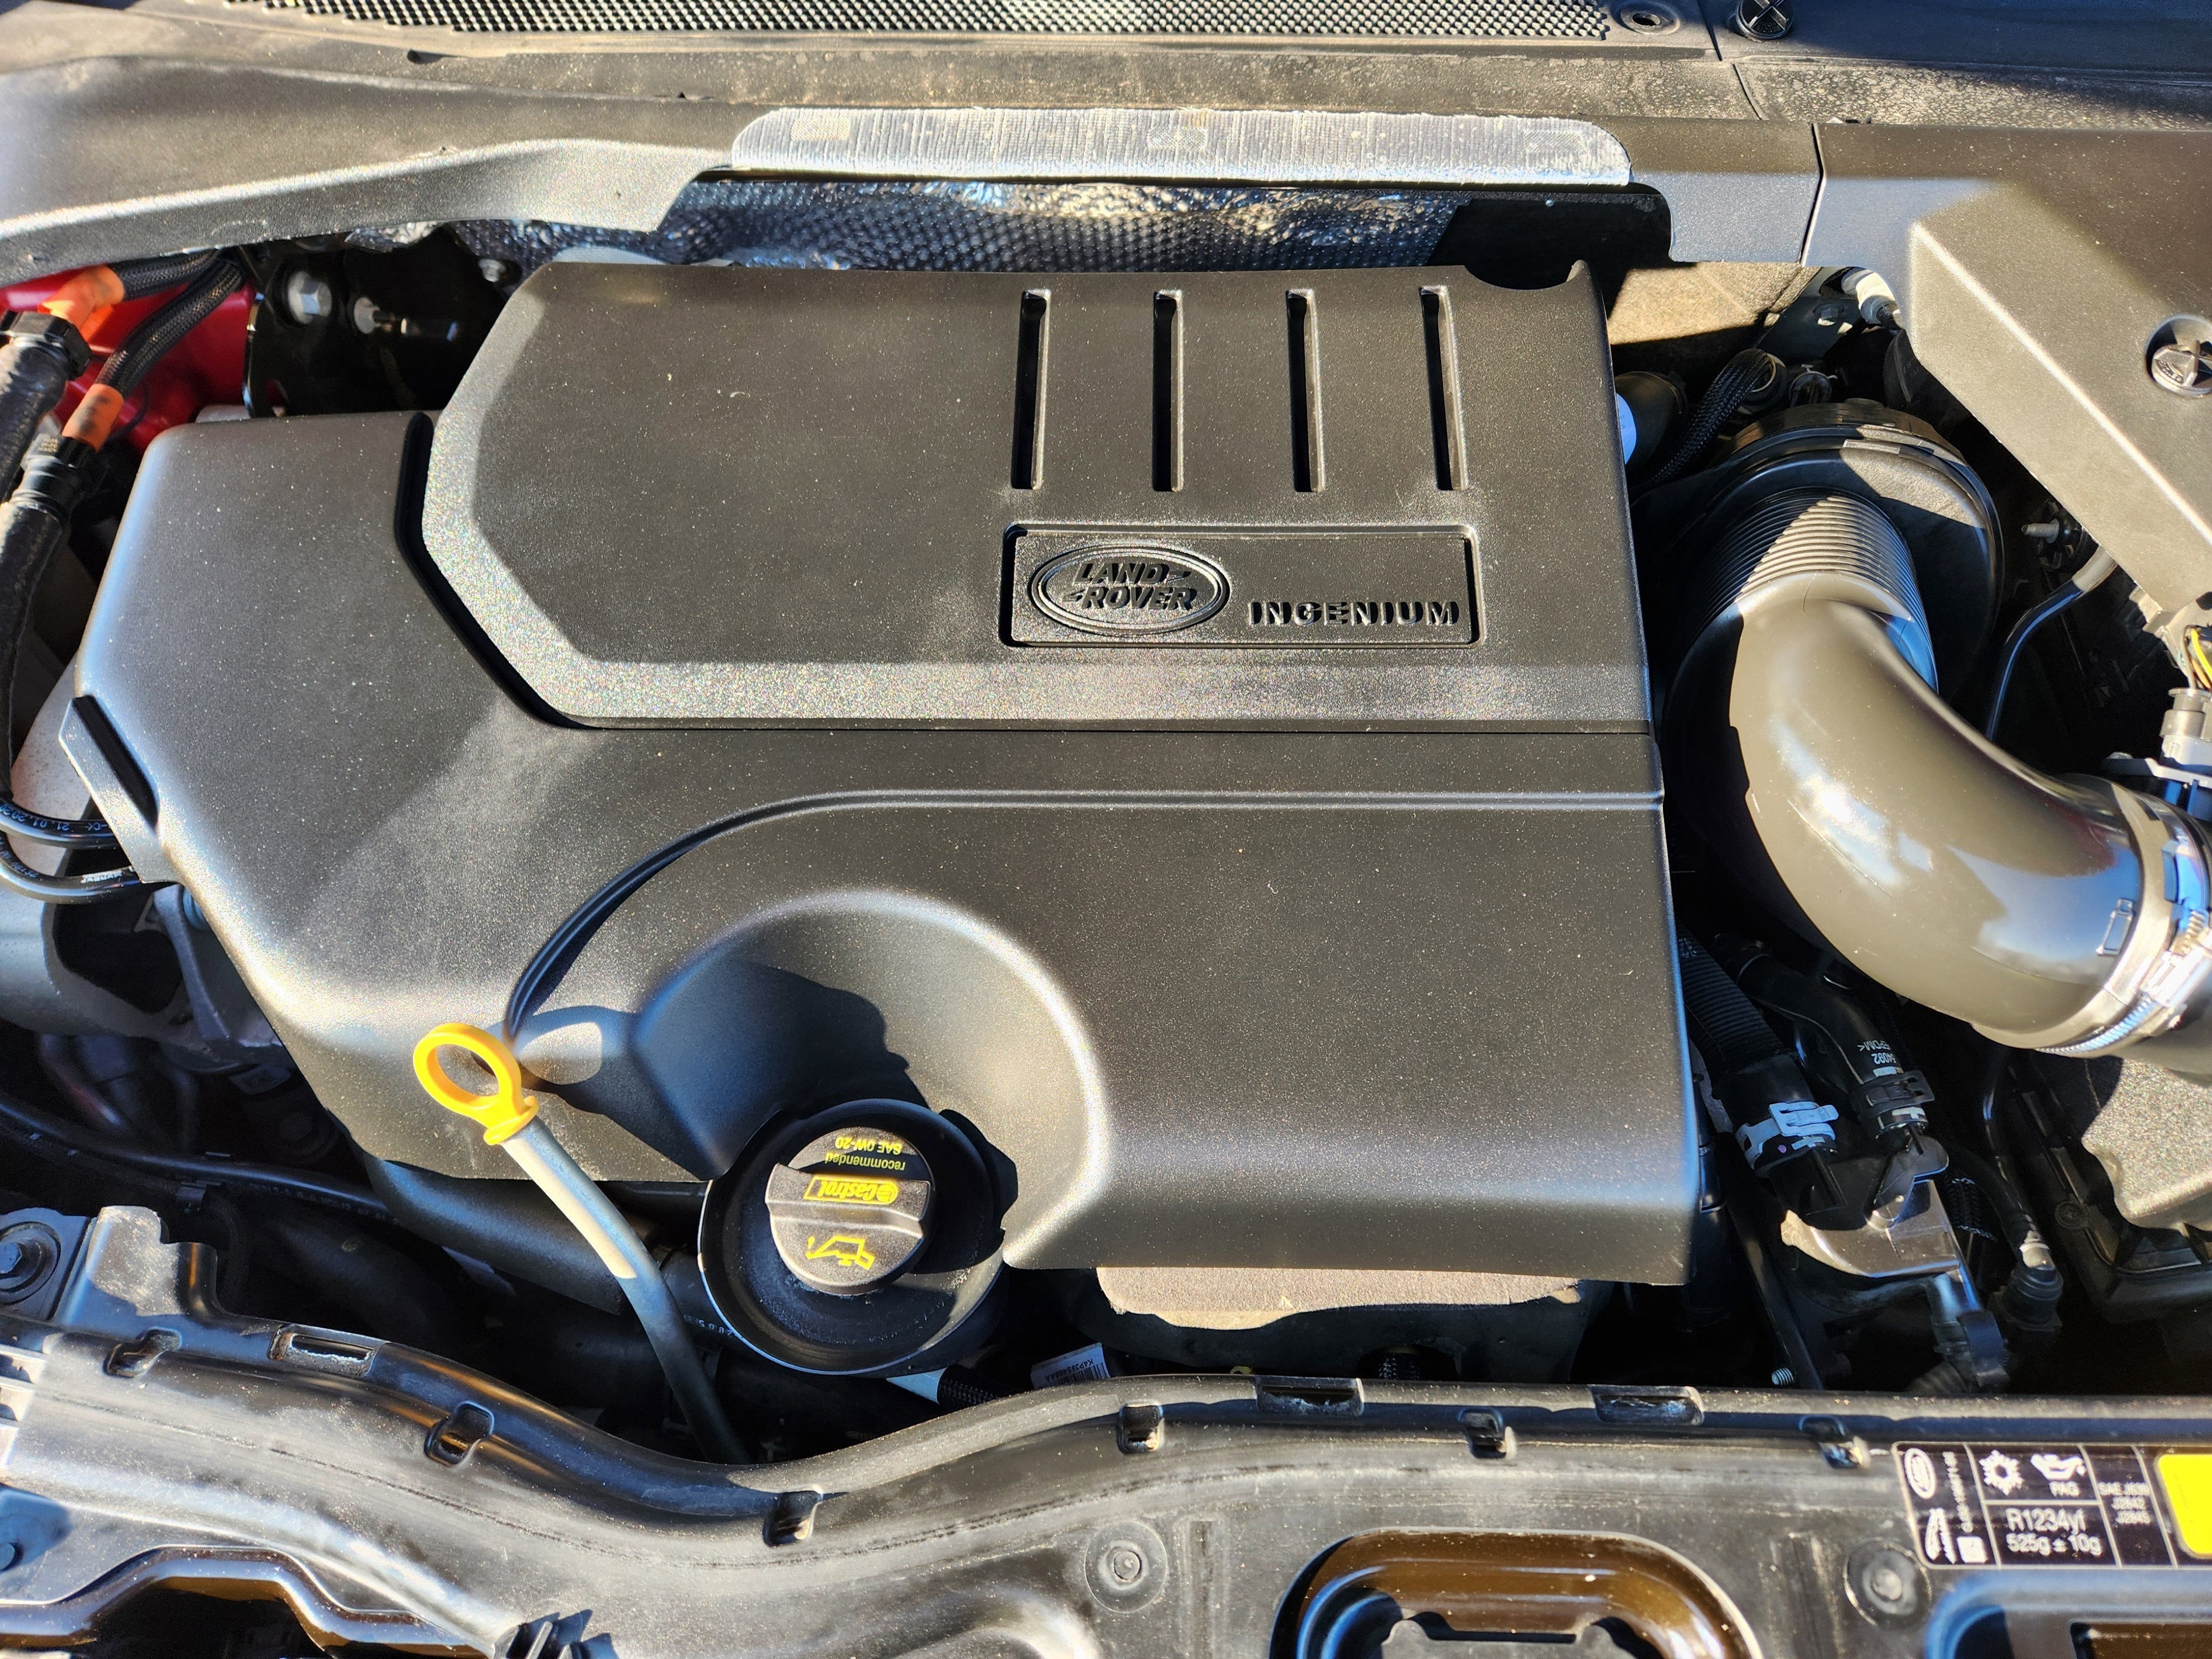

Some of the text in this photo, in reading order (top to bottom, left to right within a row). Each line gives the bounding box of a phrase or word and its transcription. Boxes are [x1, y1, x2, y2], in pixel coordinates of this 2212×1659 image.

[1073, 561, 1170, 584] LAND
[1082, 587, 1196, 609] ROVER
[1248, 601, 1459, 626] INGENIUM
[834, 1136, 902, 1156] SAE 0W-20
[825, 1152, 907, 1171] recommended
[817, 1180, 878, 1201] Castrol
[2049, 1481, 2080, 1498] PAG
[2098, 1481, 2123, 1496] SAE
[2005, 1507, 2087, 1536] R1234yf
[2005, 1532, 2052, 1557] 525g
[2067, 1533, 2103, 1557] 10g
